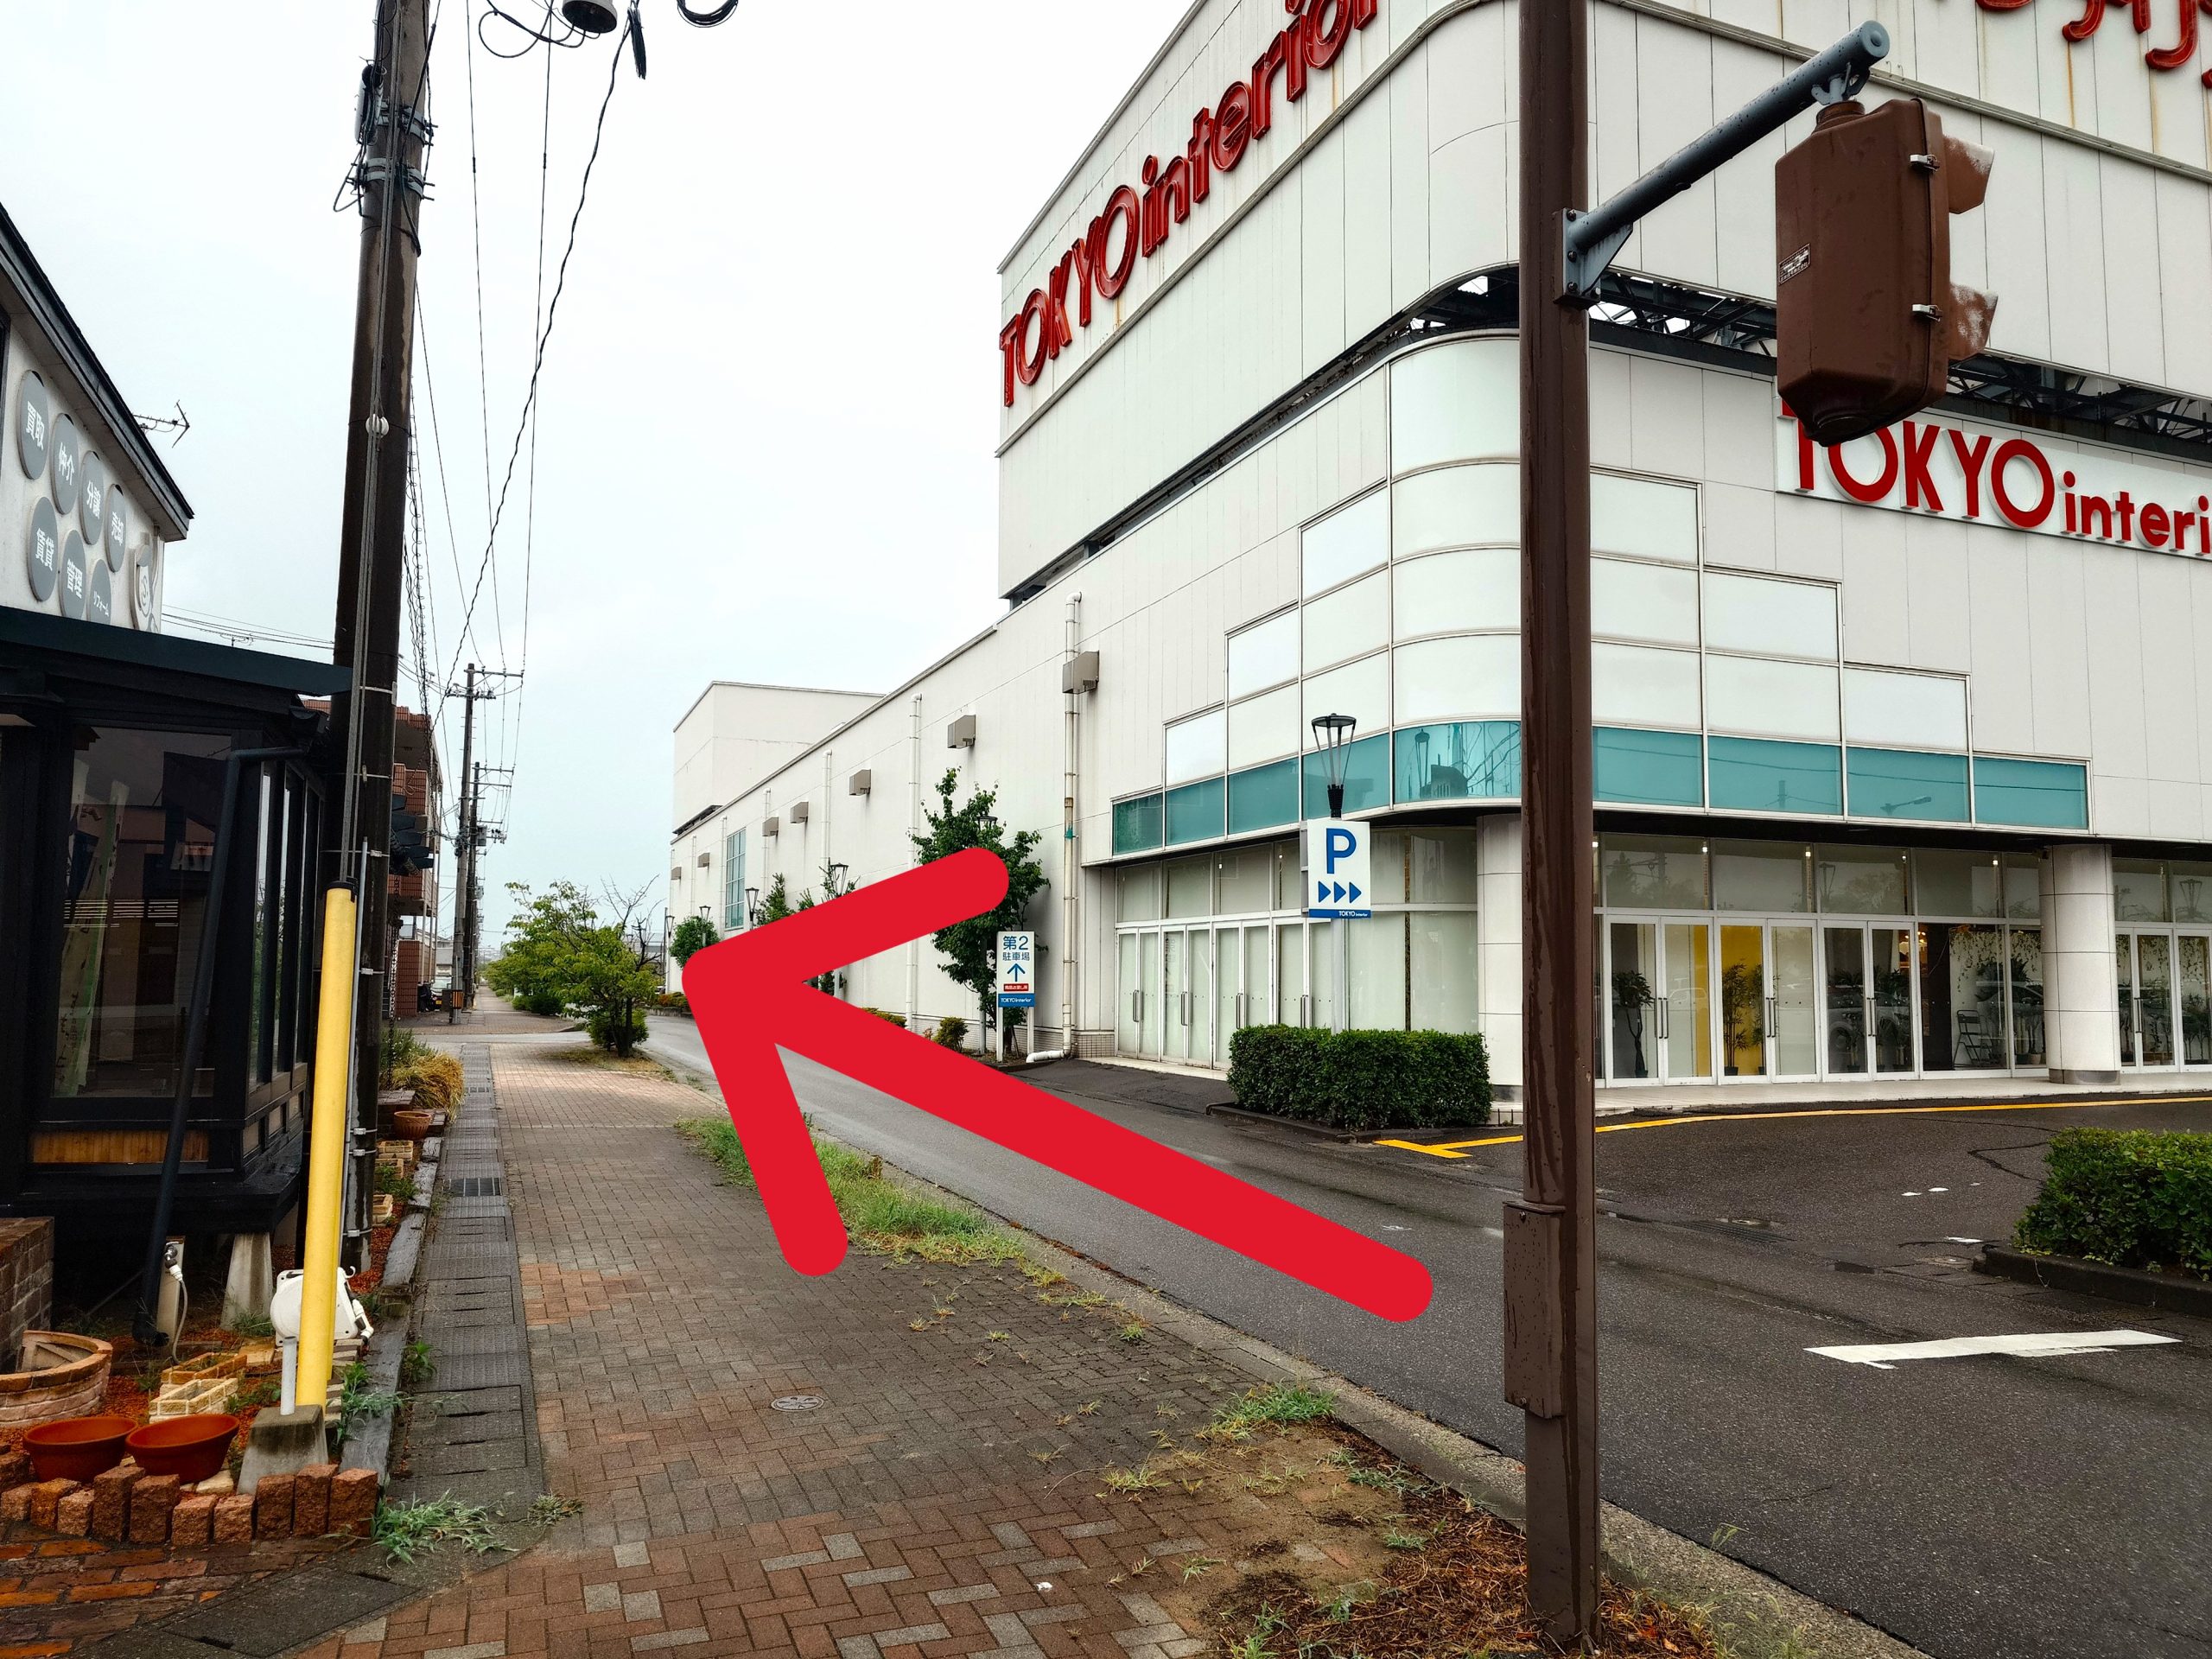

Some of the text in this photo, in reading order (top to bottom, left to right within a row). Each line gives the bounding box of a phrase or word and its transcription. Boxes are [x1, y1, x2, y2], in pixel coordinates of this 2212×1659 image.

[26, 400, 45, 451] 買取
[58, 442, 75, 486] 仲介
[35, 528, 54, 572] 賃貸
[67, 558, 83, 599] 管理
[1325, 828, 1357, 874] P
[1002, 935, 1029, 950] 第2
[1002, 952, 1030, 962] 駐車場
